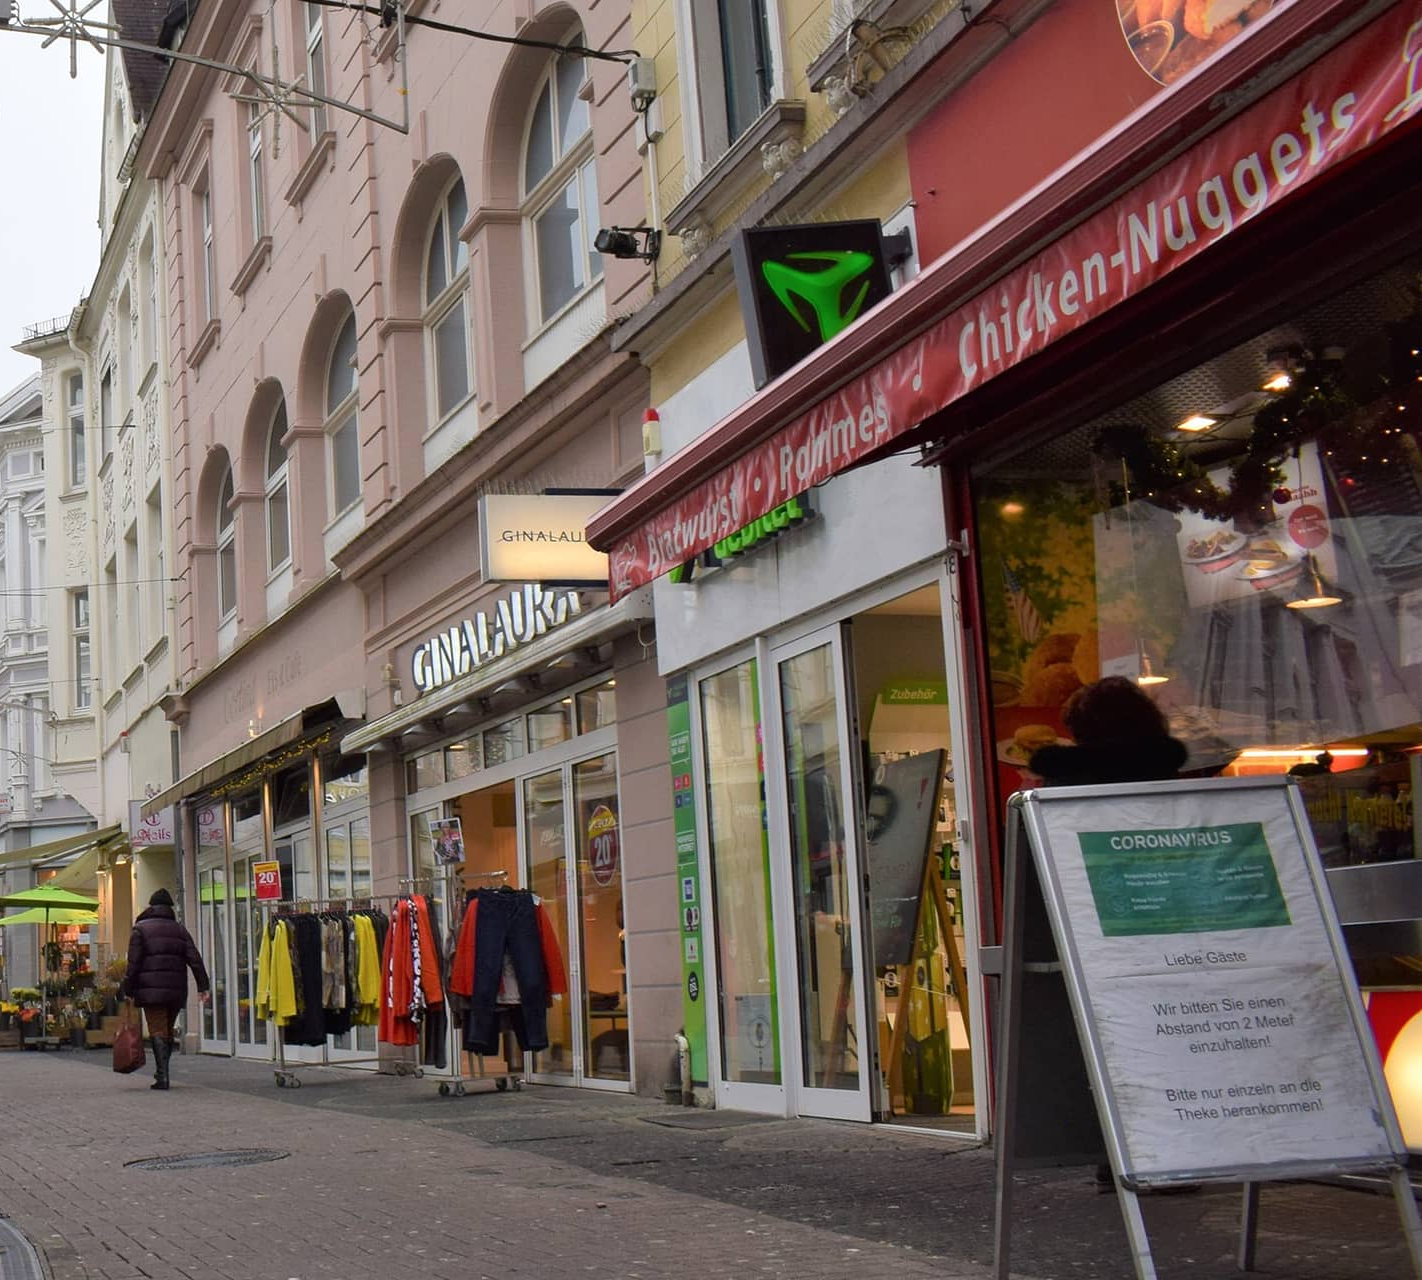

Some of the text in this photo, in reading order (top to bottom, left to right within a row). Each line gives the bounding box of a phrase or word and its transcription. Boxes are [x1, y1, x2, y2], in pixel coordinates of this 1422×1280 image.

[958, 91, 1356, 380] Chicken-Nuggets
[646, 394, 890, 572] Bratwurst Pommes
[501, 529, 586, 544] GINALAU
[944, 555, 957, 576] 18
[412, 584, 582, 692] GINALAURA
[890, 688, 938, 700] Zubehör
[1110, 831, 1233, 850] CORONAVIRUS
[1164, 951, 1247, 967] Liebe Gäste
[1153, 996, 1286, 1017] Wir bitten Sie einen
[1156, 1013, 1295, 1035] Abstand von 2 Meter
[1189, 1035, 1272, 1053] einzuhalten!
[1166, 1078, 1321, 1102] Bitte nur einzeln an die
[1174, 1098, 1325, 1121] Theke herankommen!
